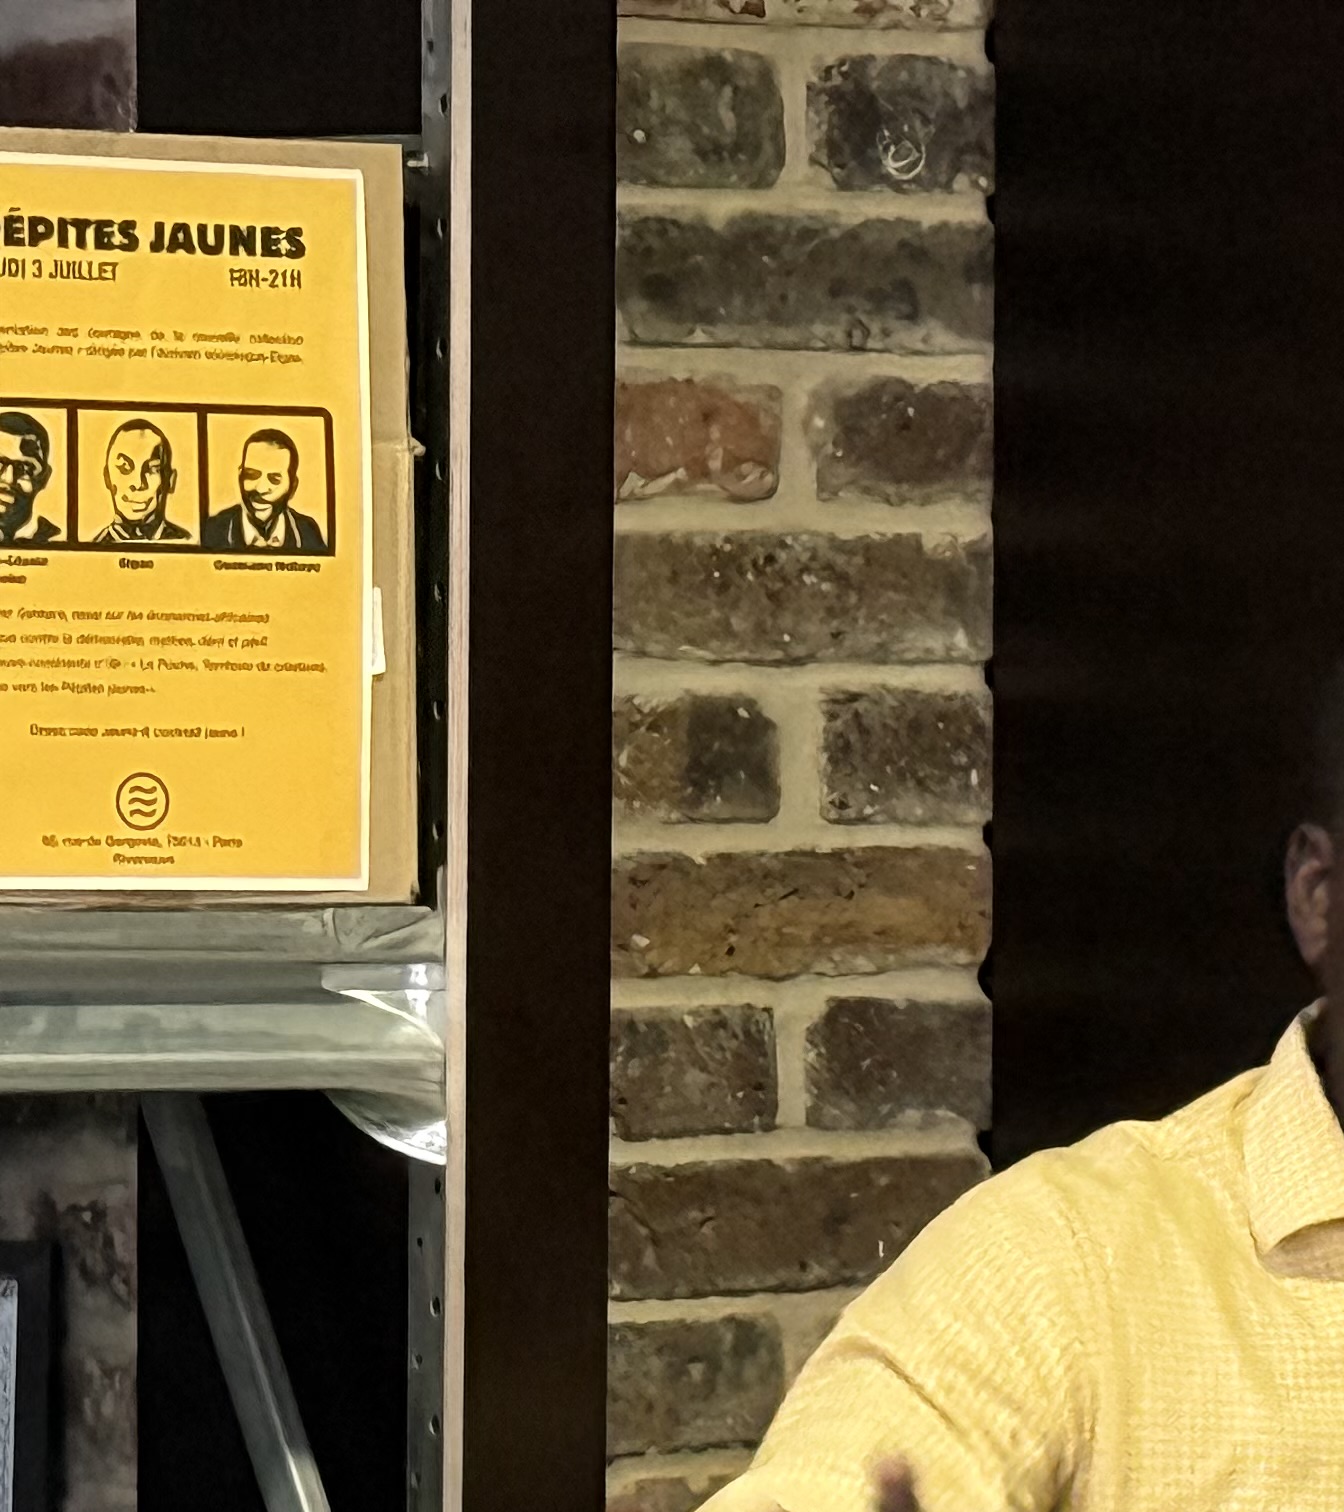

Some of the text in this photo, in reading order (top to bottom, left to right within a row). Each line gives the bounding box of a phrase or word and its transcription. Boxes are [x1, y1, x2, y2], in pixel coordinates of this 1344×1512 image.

[0, 207, 306, 259] ÉPITES JAUNES
[32, 259, 42, 278] 3
[48, 259, 118, 281] JUILLET
